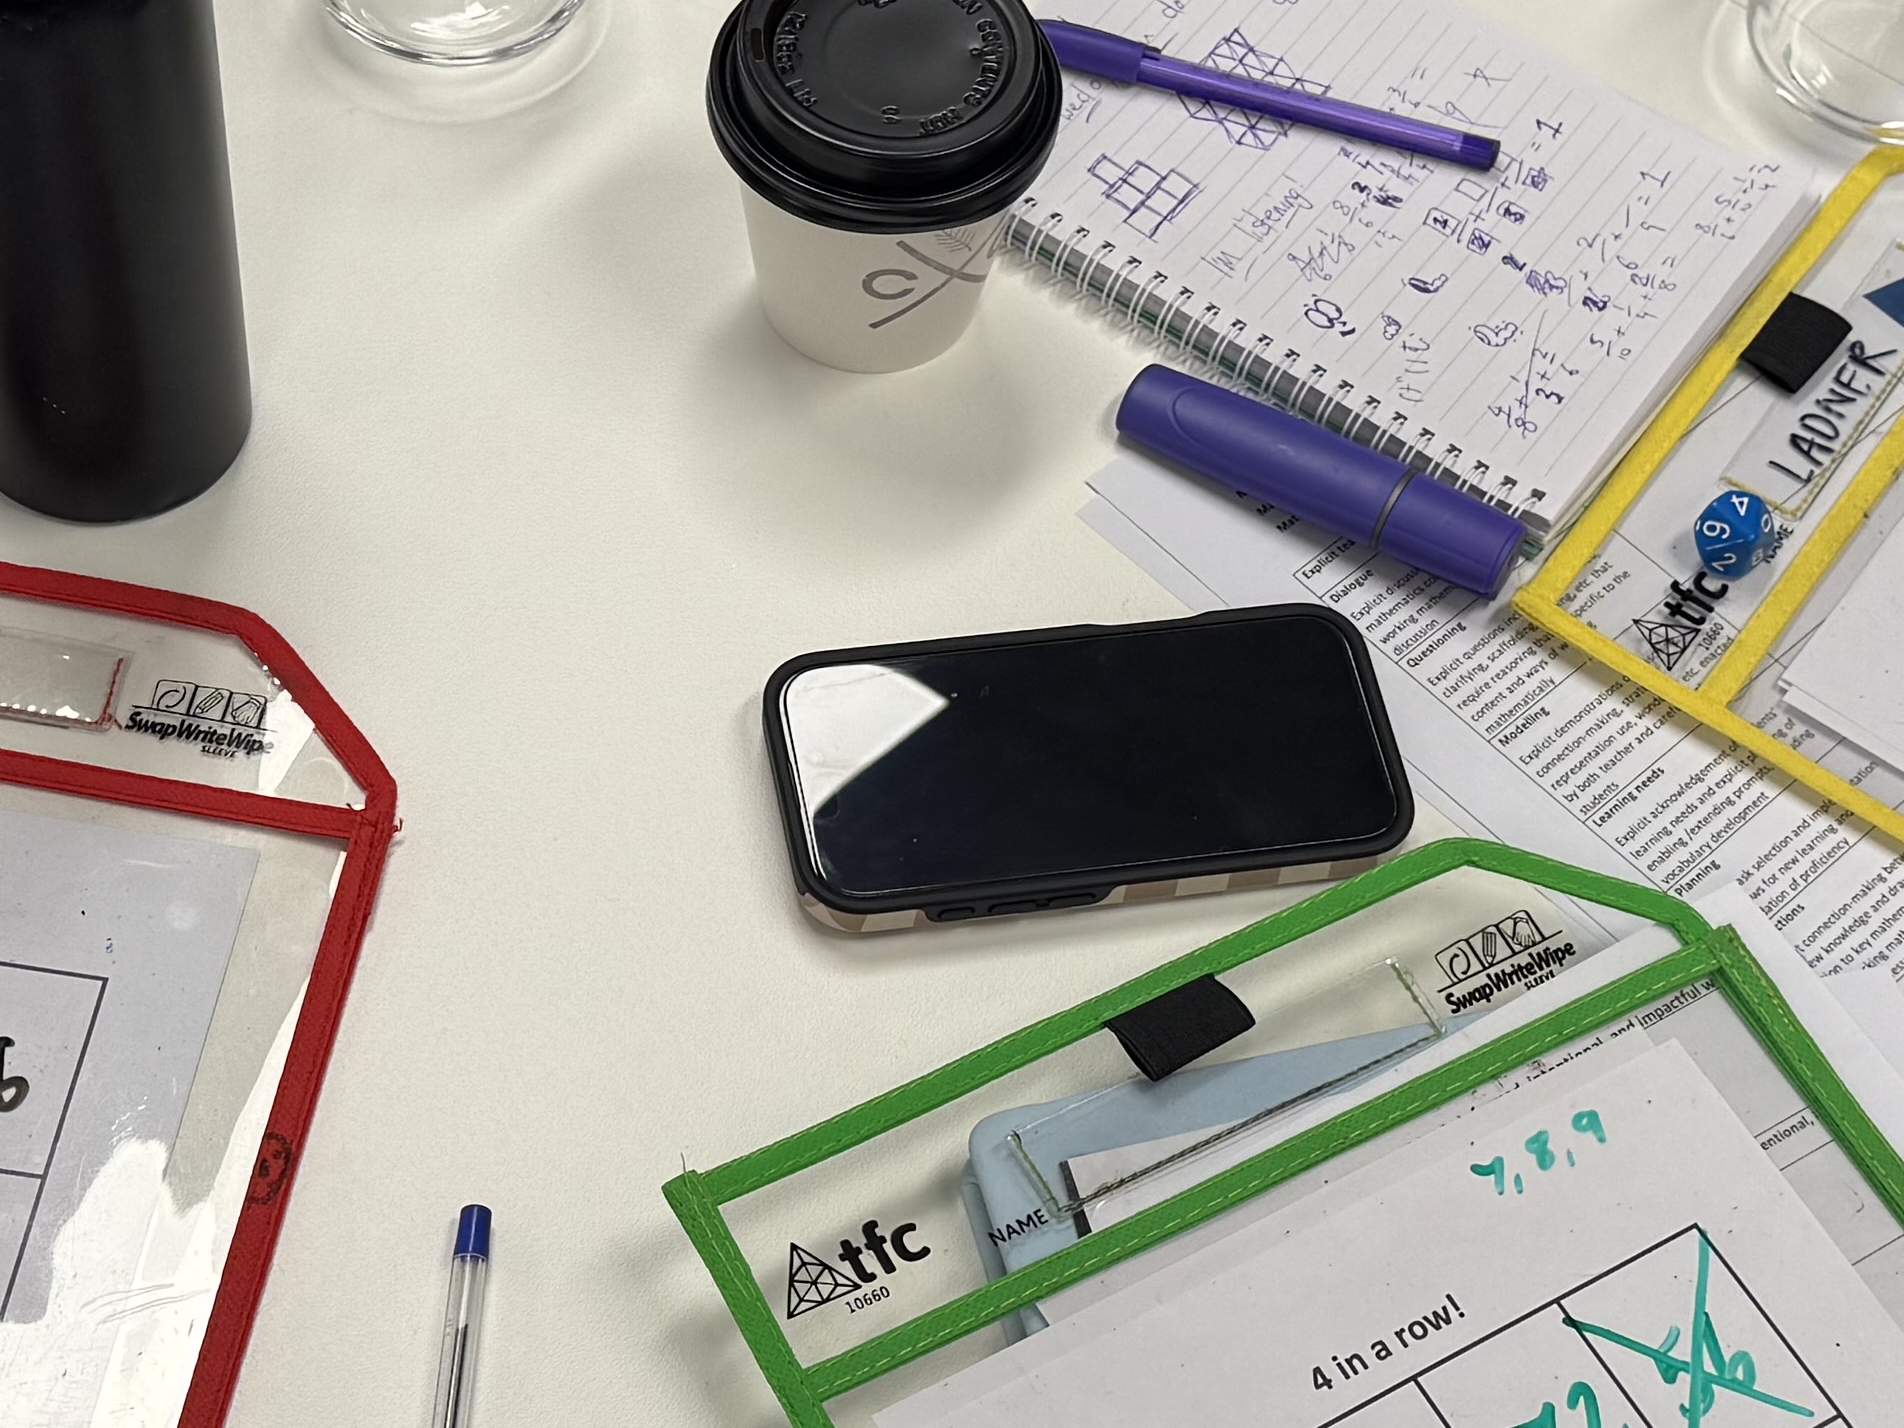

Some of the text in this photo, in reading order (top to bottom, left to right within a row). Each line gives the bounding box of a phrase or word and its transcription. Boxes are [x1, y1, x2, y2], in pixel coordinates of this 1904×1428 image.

[1768, 338, 1898, 486] LADNER
[1328, 568, 1374, 604] Dialogue
[1406, 621, 1467, 669] Questioning
[1698, 621, 1725, 652] 10660
[1485, 676, 1556, 736] mathematically
[1497, 706, 1550, 748] Modelling
[124, 712, 276, 756] SwapWriteWipe
[1592, 766, 1665, 828] Learning needs
[1674, 859, 1722, 898] Planning
[1443, 940, 1577, 1015] SwapWriteWipe
[987, 1205, 1051, 1249] NAME
[840, 1218, 931, 1291] tfc
[844, 1283, 894, 1318] 10660
[1312, 1293, 1465, 1390] 4 in a row!
